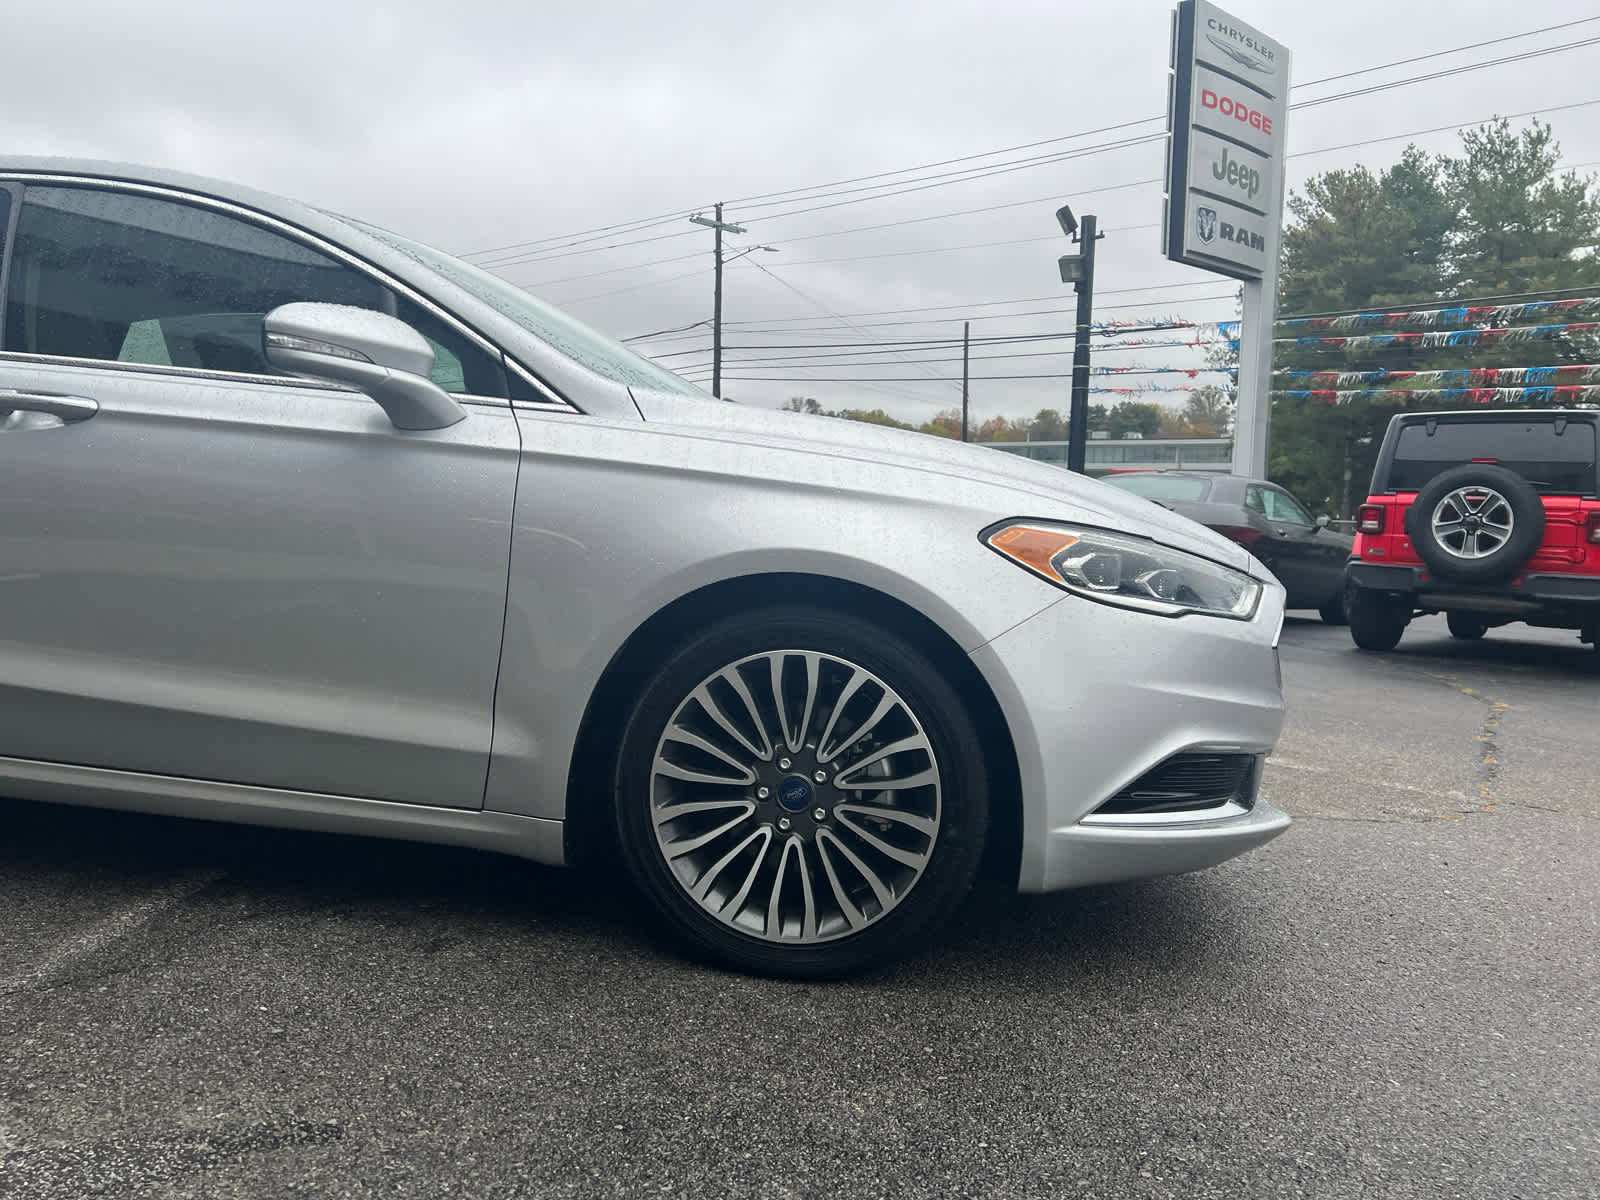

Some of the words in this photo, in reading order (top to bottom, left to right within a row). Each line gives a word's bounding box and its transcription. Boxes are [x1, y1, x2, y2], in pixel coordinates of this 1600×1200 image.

[1207, 18, 1275, 61] CHRYSLER
[1201, 88, 1272, 135] DODGE
[1212, 147, 1260, 199] Jeep
[1220, 221, 1264, 252] RAM
